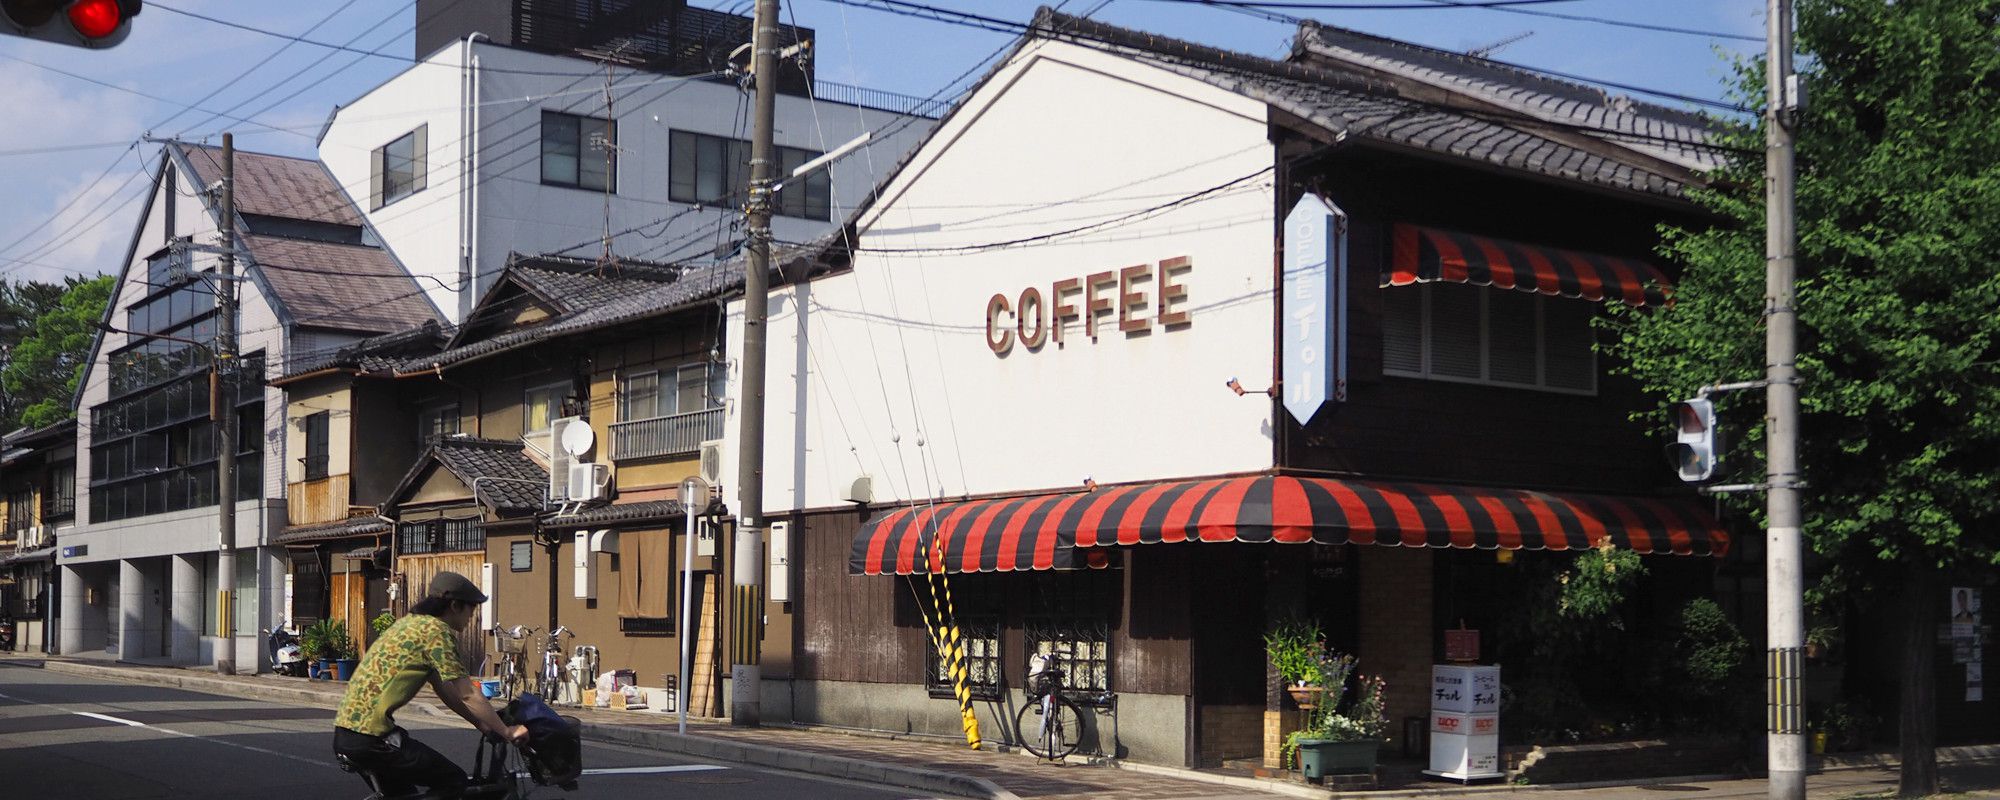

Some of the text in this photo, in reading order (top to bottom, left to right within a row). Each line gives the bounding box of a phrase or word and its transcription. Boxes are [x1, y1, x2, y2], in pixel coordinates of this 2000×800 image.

[1296, 207, 1315, 301] COFFEE
[986, 255, 1191, 355] COFFEE
[1435, 688, 1462, 701] チロル
[1438, 716, 1459, 727] UCC
